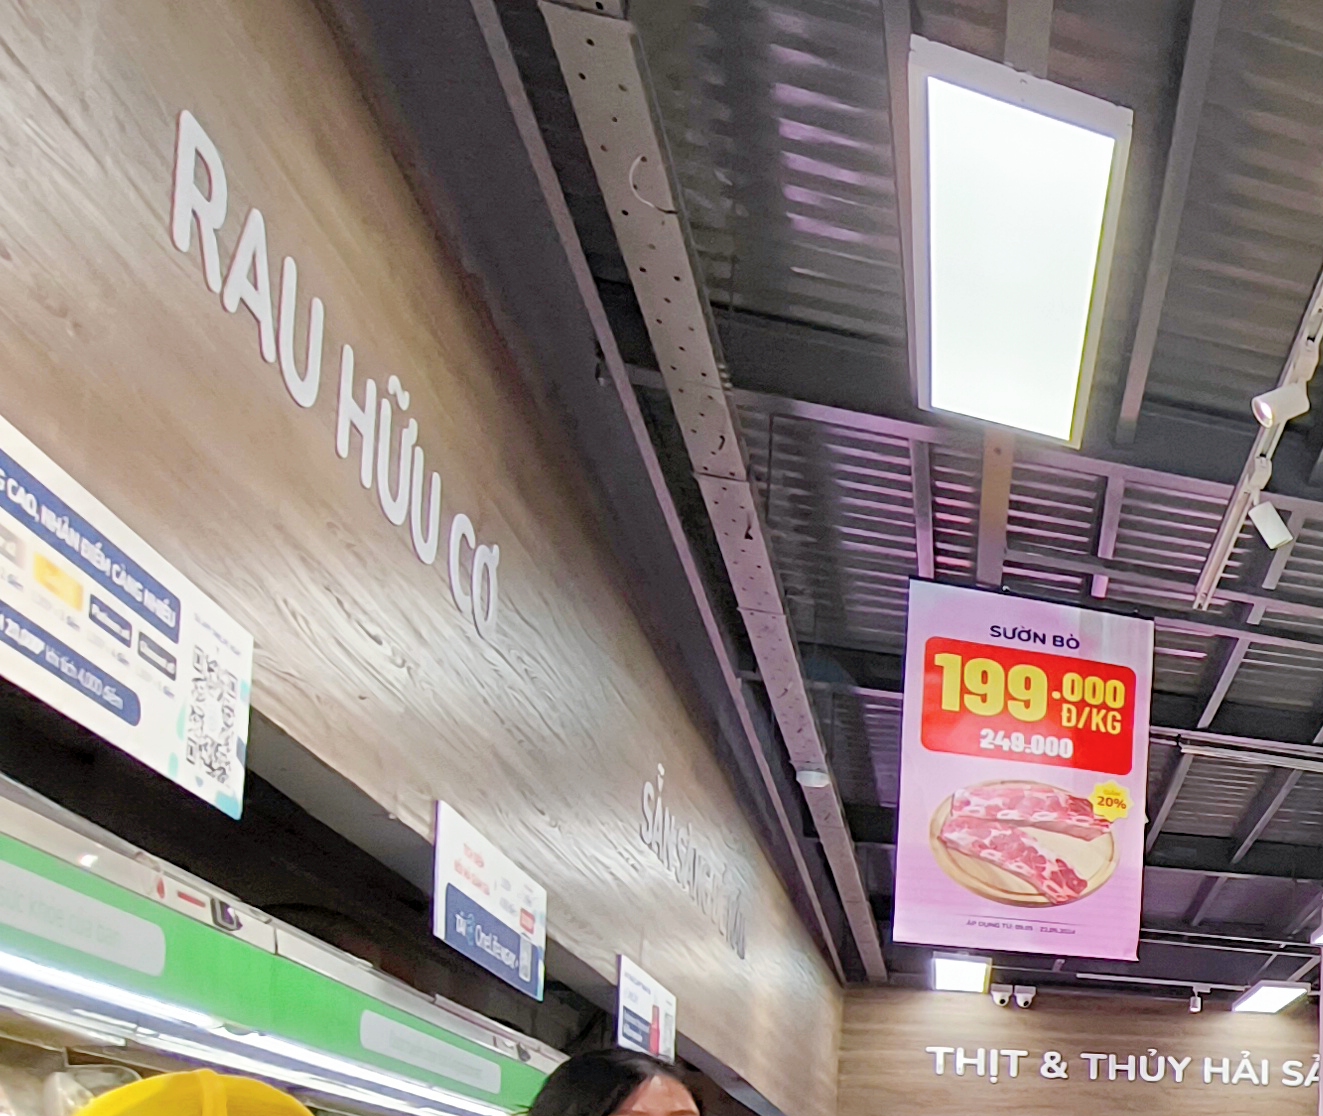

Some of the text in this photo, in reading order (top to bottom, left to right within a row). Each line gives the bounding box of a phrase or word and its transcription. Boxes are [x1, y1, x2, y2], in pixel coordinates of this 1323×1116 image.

[171, 110, 500, 634] RAU HỮU CƠ
[988, 624, 1080, 651] SƯỜN BÒ
[1061, 703, 1122, 736] Đ/KG
[1097, 794, 1128, 814] 20%
[925, 1045, 1030, 1085] THỊT
[1039, 1050, 1068, 1080] &
[1079, 1048, 1193, 1084] THỦY
[1202, 1050, 1270, 1086] HẢI
